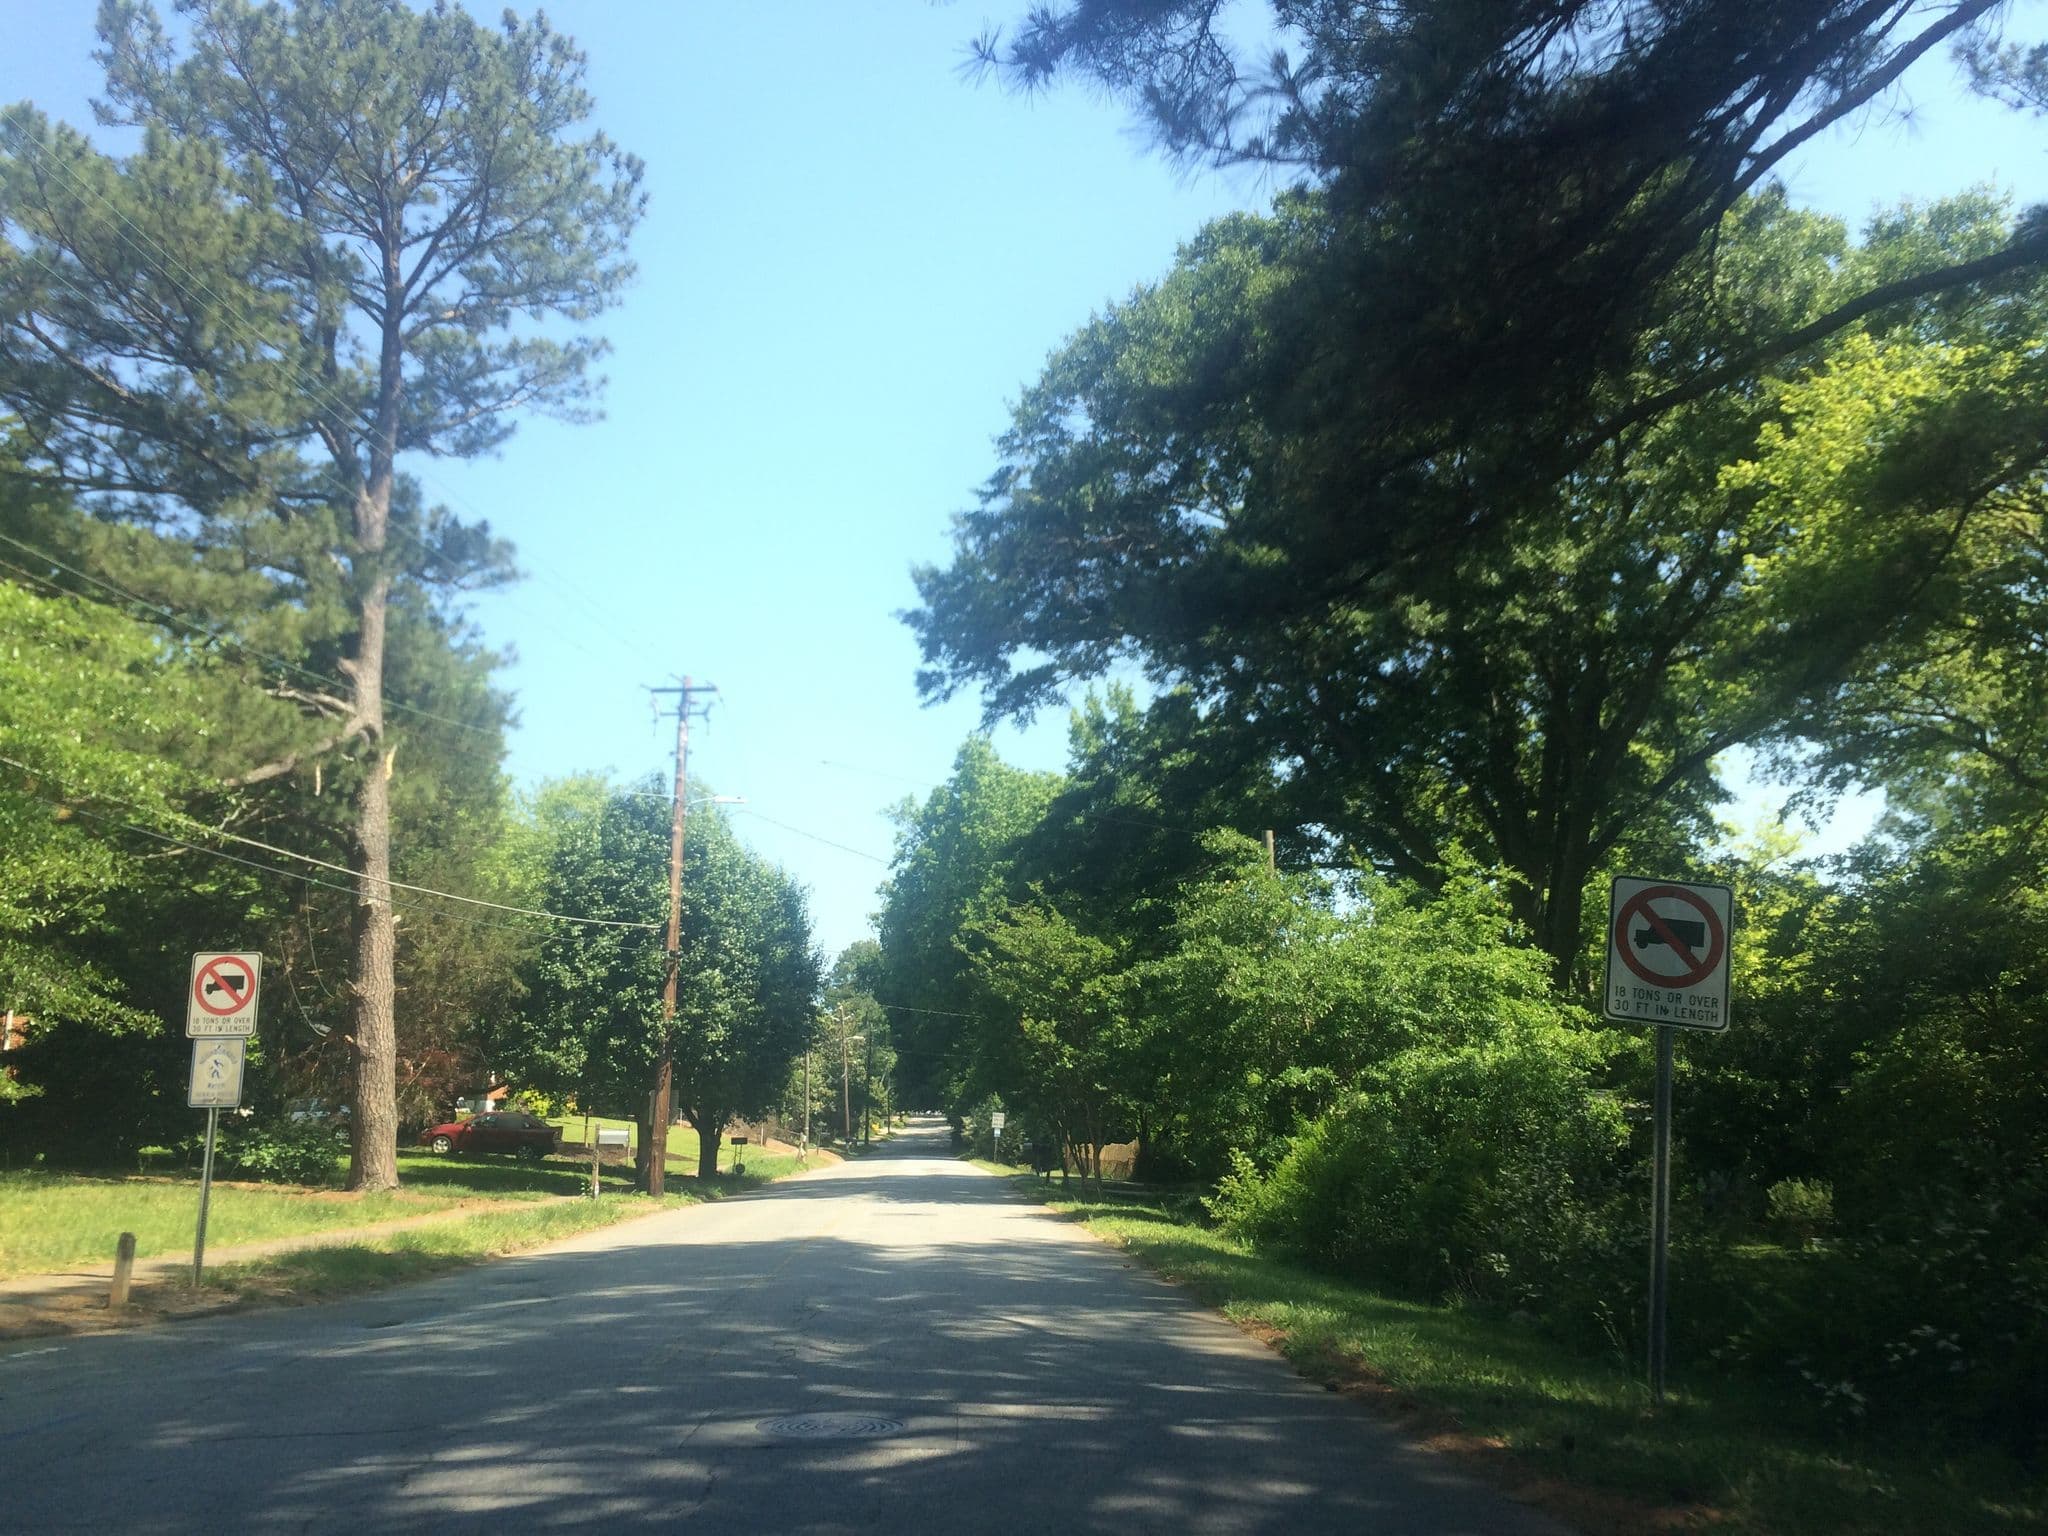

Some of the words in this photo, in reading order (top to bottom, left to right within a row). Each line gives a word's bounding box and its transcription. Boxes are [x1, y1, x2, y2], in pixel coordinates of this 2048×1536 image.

[1615, 986, 1625, 997] 18
[1632, 987, 1660, 1001] TONS
[1667, 992, 1682, 1004] OR
[1689, 994, 1719, 1008] OVER
[1614, 999, 1629, 1011] 30
[1636, 1002, 1649, 1014] FT
[1656, 1005, 1669, 1016] IN
[1674, 1007, 1719, 1022] LENGTH
[202, 1017, 219, 1025] TONS
[222, 1017, 231, 1025] OR
[234, 1017, 251, 1025] OVER
[204, 1025, 212, 1033] FT
[225, 1025, 251, 1033] LENGTH
